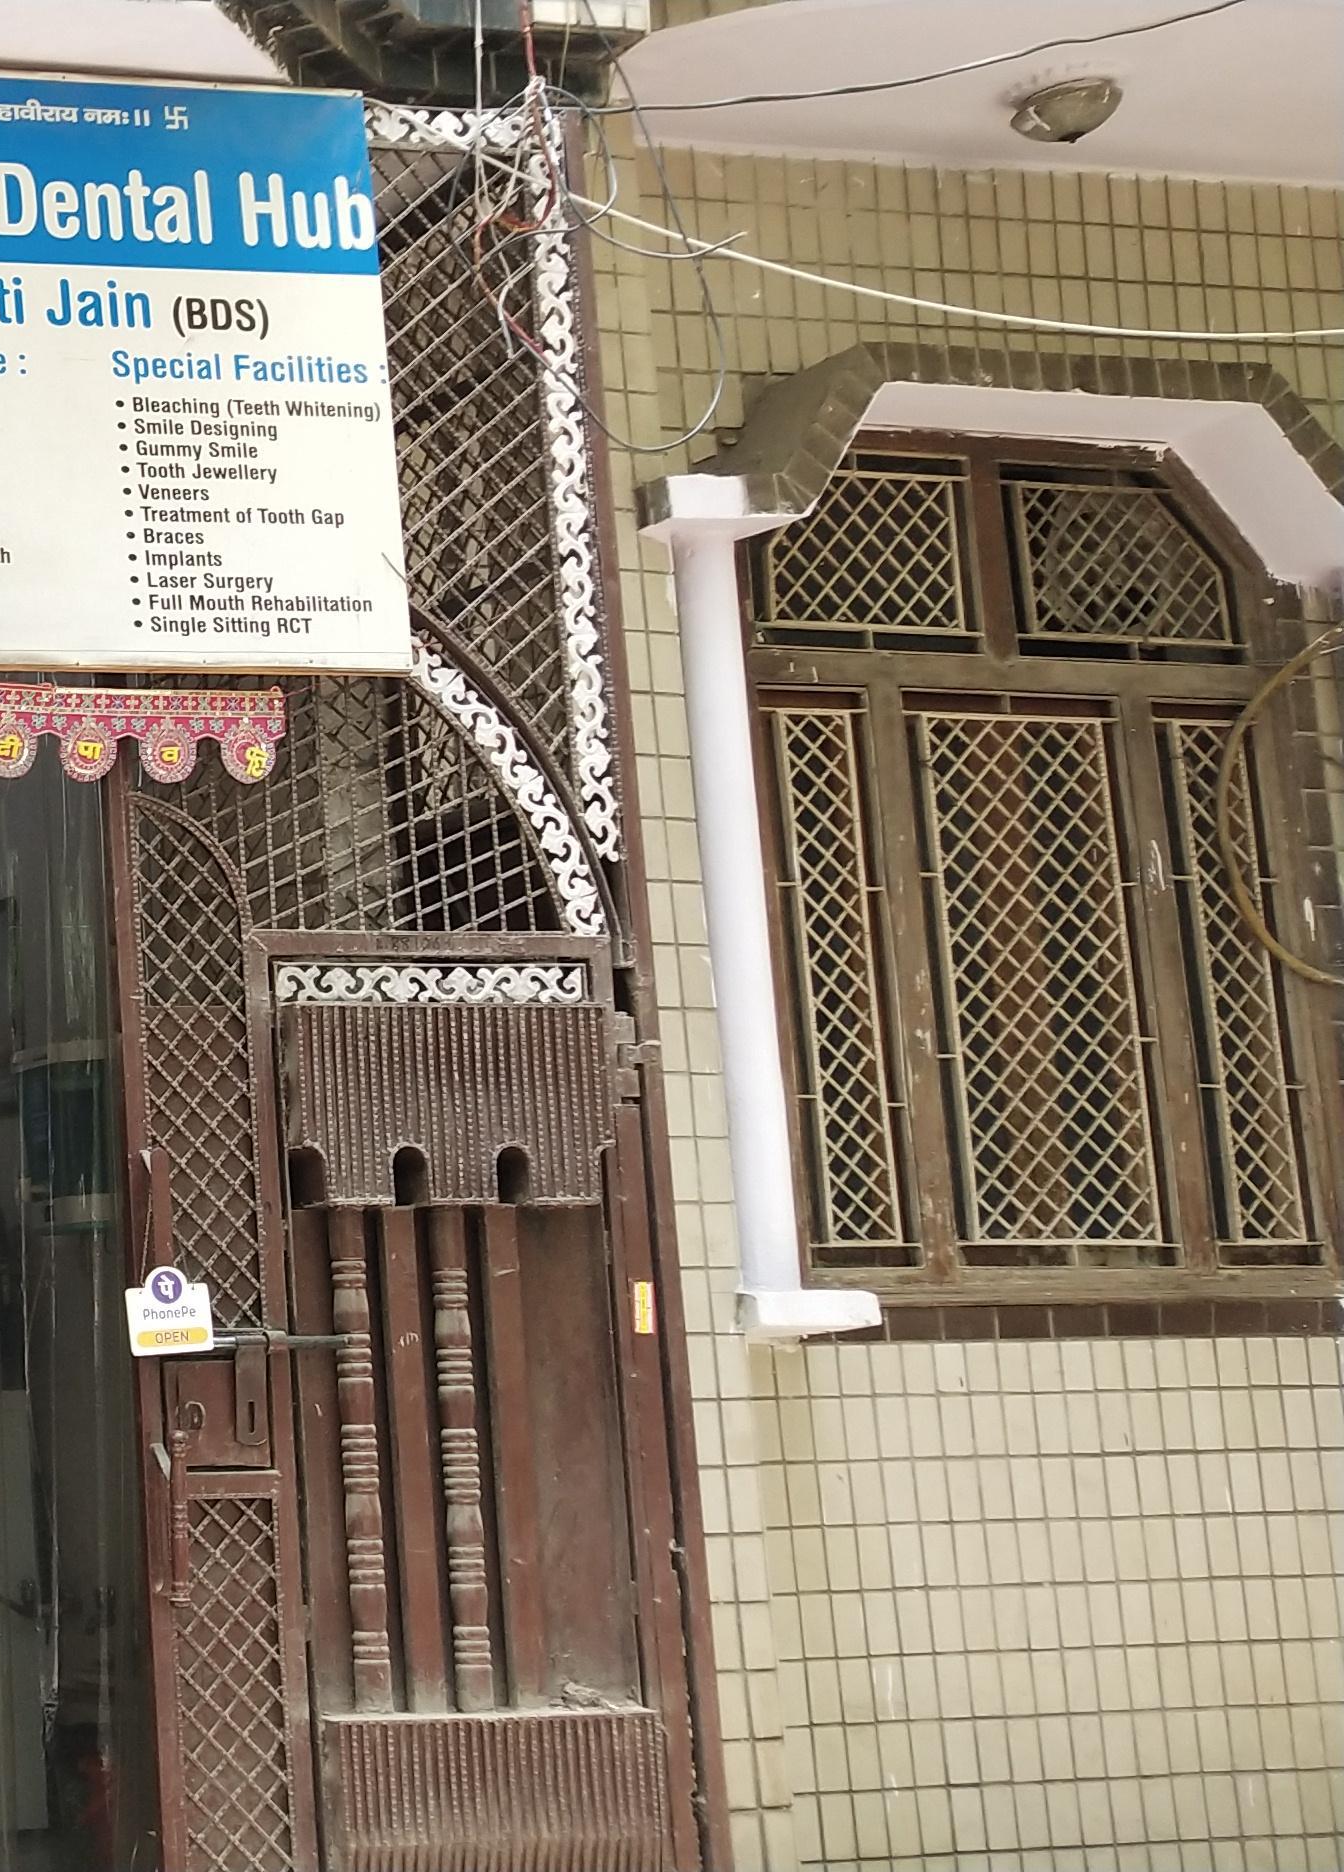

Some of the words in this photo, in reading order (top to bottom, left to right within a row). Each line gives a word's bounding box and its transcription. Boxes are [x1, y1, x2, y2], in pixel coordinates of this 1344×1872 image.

[239, 172, 376, 251] Hub
[45, 280, 152, 329] Jain
[173, 296, 270, 339] (BDS)
[112, 351, 221, 384] Special
[234, 355, 368, 383] Facilities
[133, 398, 219, 417] Bleaching
[227, 400, 280, 418] (Teeth
[285, 401, 381, 422] Whitening)
[134, 420, 184, 435] Smile
[191, 421, 277, 440] Designing
[136, 442, 202, 460] Gummy
[209, 443, 258, 458] Smile
[137, 463, 185, 478] Tooth
[193, 464, 276, 483] Jewellery
[139, 485, 210, 500] Veneers
[140, 507, 230, 523] Treatment
[236, 508, 252, 523] of
[257, 509, 305, 524] Tooth
[312, 509, 344, 526] Gap
[144, 529, 204, 544] Braces
[146, 551, 222, 569] Implants
[148, 573, 197, 589] Laser
[204, 574, 273, 593] Surgery
[149, 596, 182, 610] Full
[190, 596, 244, 611] Mouth
[252, 596, 372, 612] Rehabilitation
[151, 618, 206, 635] Single
[213, 618, 270, 636] Sitting
[278, 619, 312, 634] RCT
[143, 1305, 196, 1319] PhonePe
[155, 1331, 188, 1343] OPEN
